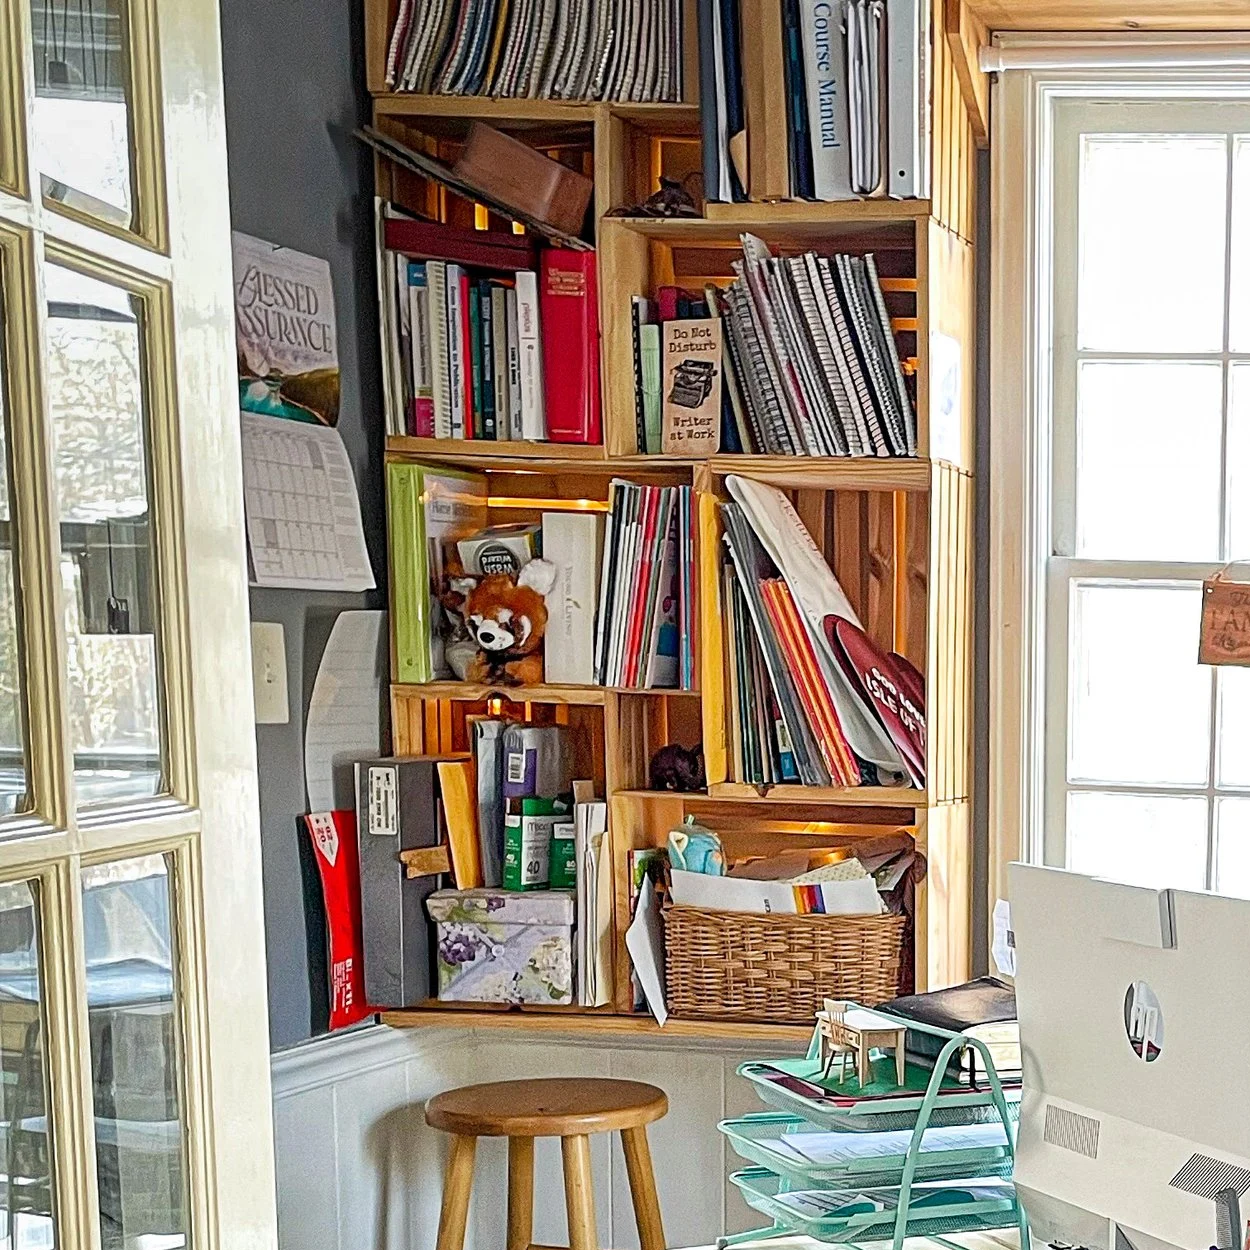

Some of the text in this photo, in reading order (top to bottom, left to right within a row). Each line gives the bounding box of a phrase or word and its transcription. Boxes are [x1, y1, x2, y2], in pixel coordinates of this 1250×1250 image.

[813, 3, 841, 149] Course Manual
[673, 327, 711, 339] Do Not
[669, 341, 717, 353] Disturb
[673, 417, 713, 428] Writer
[670, 428, 715, 440] at Work
[481, 555, 513, 564] Wizard
[527, 861, 540, 875] 40
